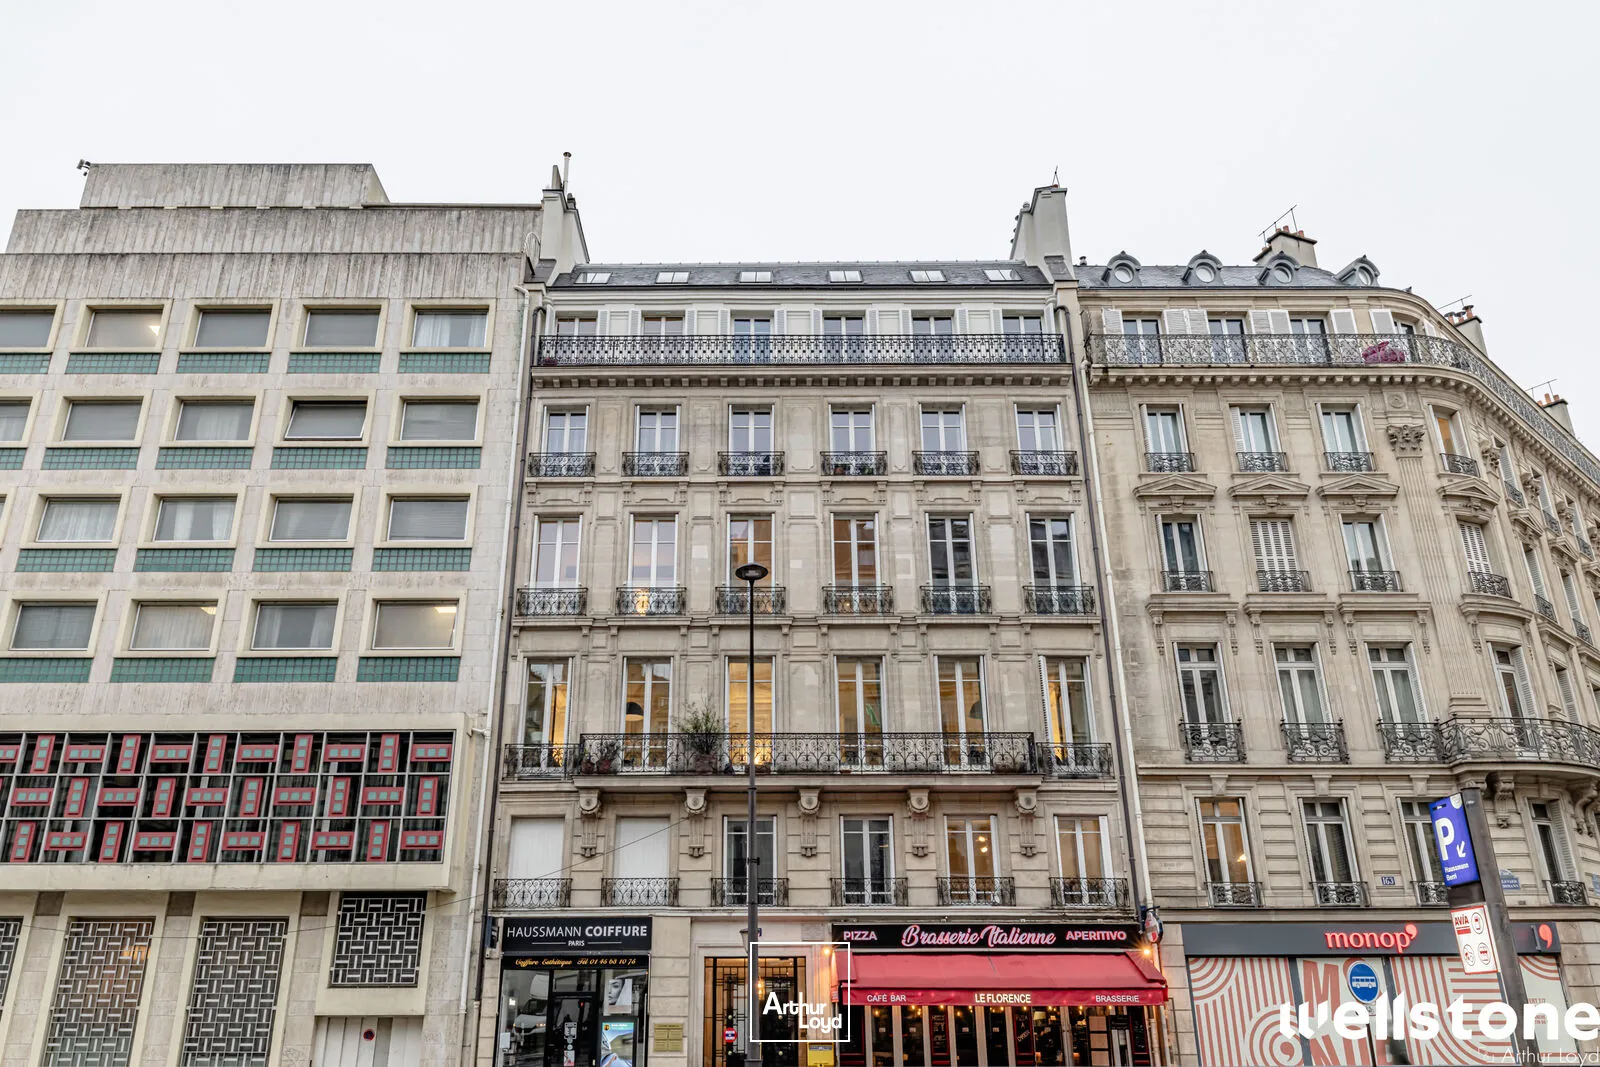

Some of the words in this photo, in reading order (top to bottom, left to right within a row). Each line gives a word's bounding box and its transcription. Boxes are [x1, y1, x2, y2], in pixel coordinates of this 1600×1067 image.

[1434, 817, 1455, 861] P
[507, 926, 582, 938] HAUSSMANN
[585, 925, 648, 937] COIFFURE
[843, 930, 878, 941] PIZZA
[901, 924, 980, 947] Brasserie
[980, 924, 1057, 948] Italienne
[1065, 930, 1127, 941] APERITIVO
[866, 993, 888, 1002] CAFÉ
[890, 994, 907, 1002] BAR
[974, 993, 986, 1003] LE
[986, 993, 1032, 1004] FLORENCE
[1095, 994, 1140, 1003] BRASSERIE
